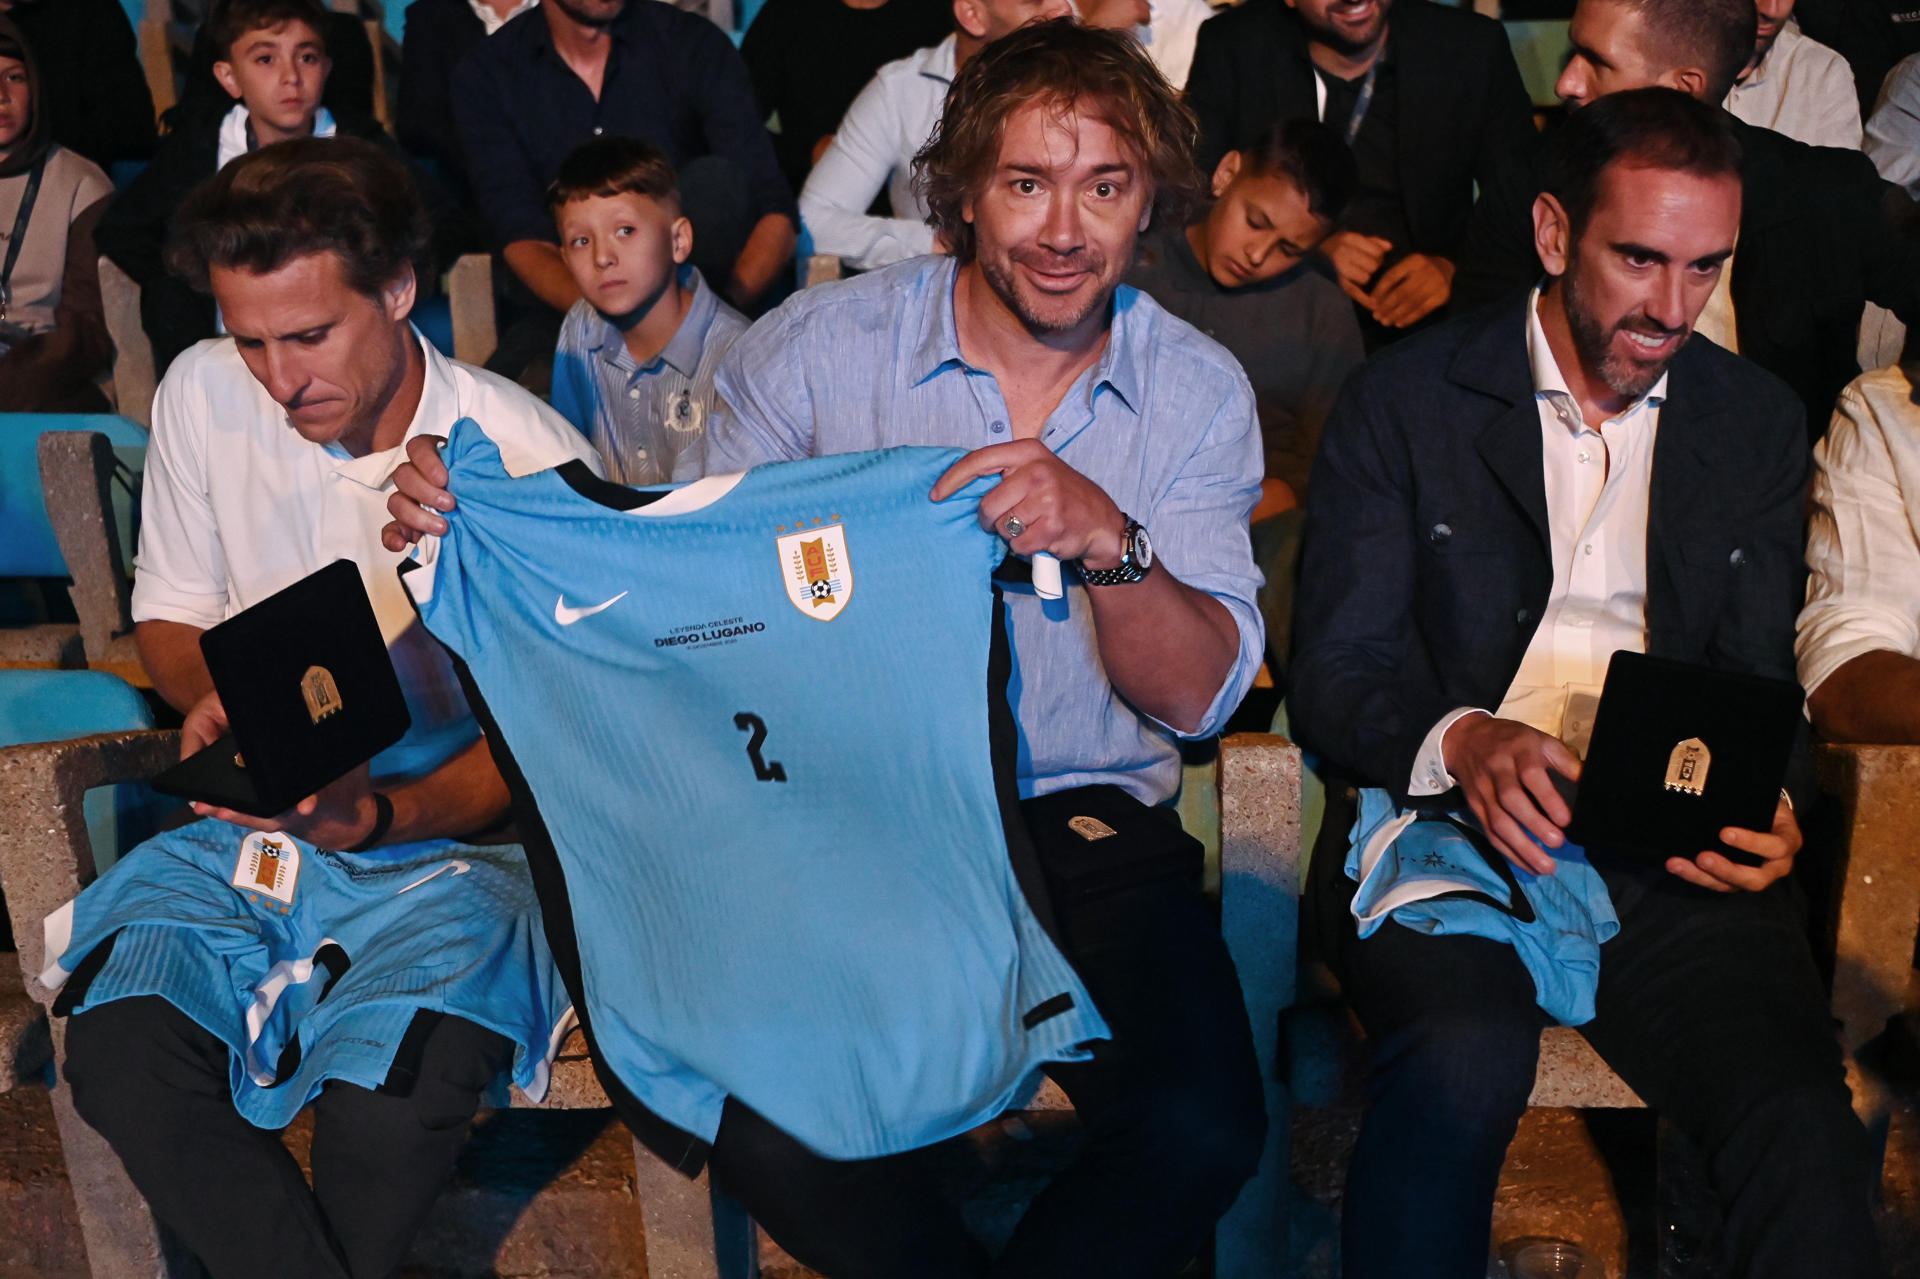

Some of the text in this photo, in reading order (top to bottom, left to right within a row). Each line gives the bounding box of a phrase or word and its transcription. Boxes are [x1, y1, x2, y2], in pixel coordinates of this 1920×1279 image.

[654, 633, 700, 648] DIEGO
[702, 622, 766, 641] LUGANO
[669, 616, 744, 634] LEYENDA CELESTE
[733, 712, 788, 783] 2
